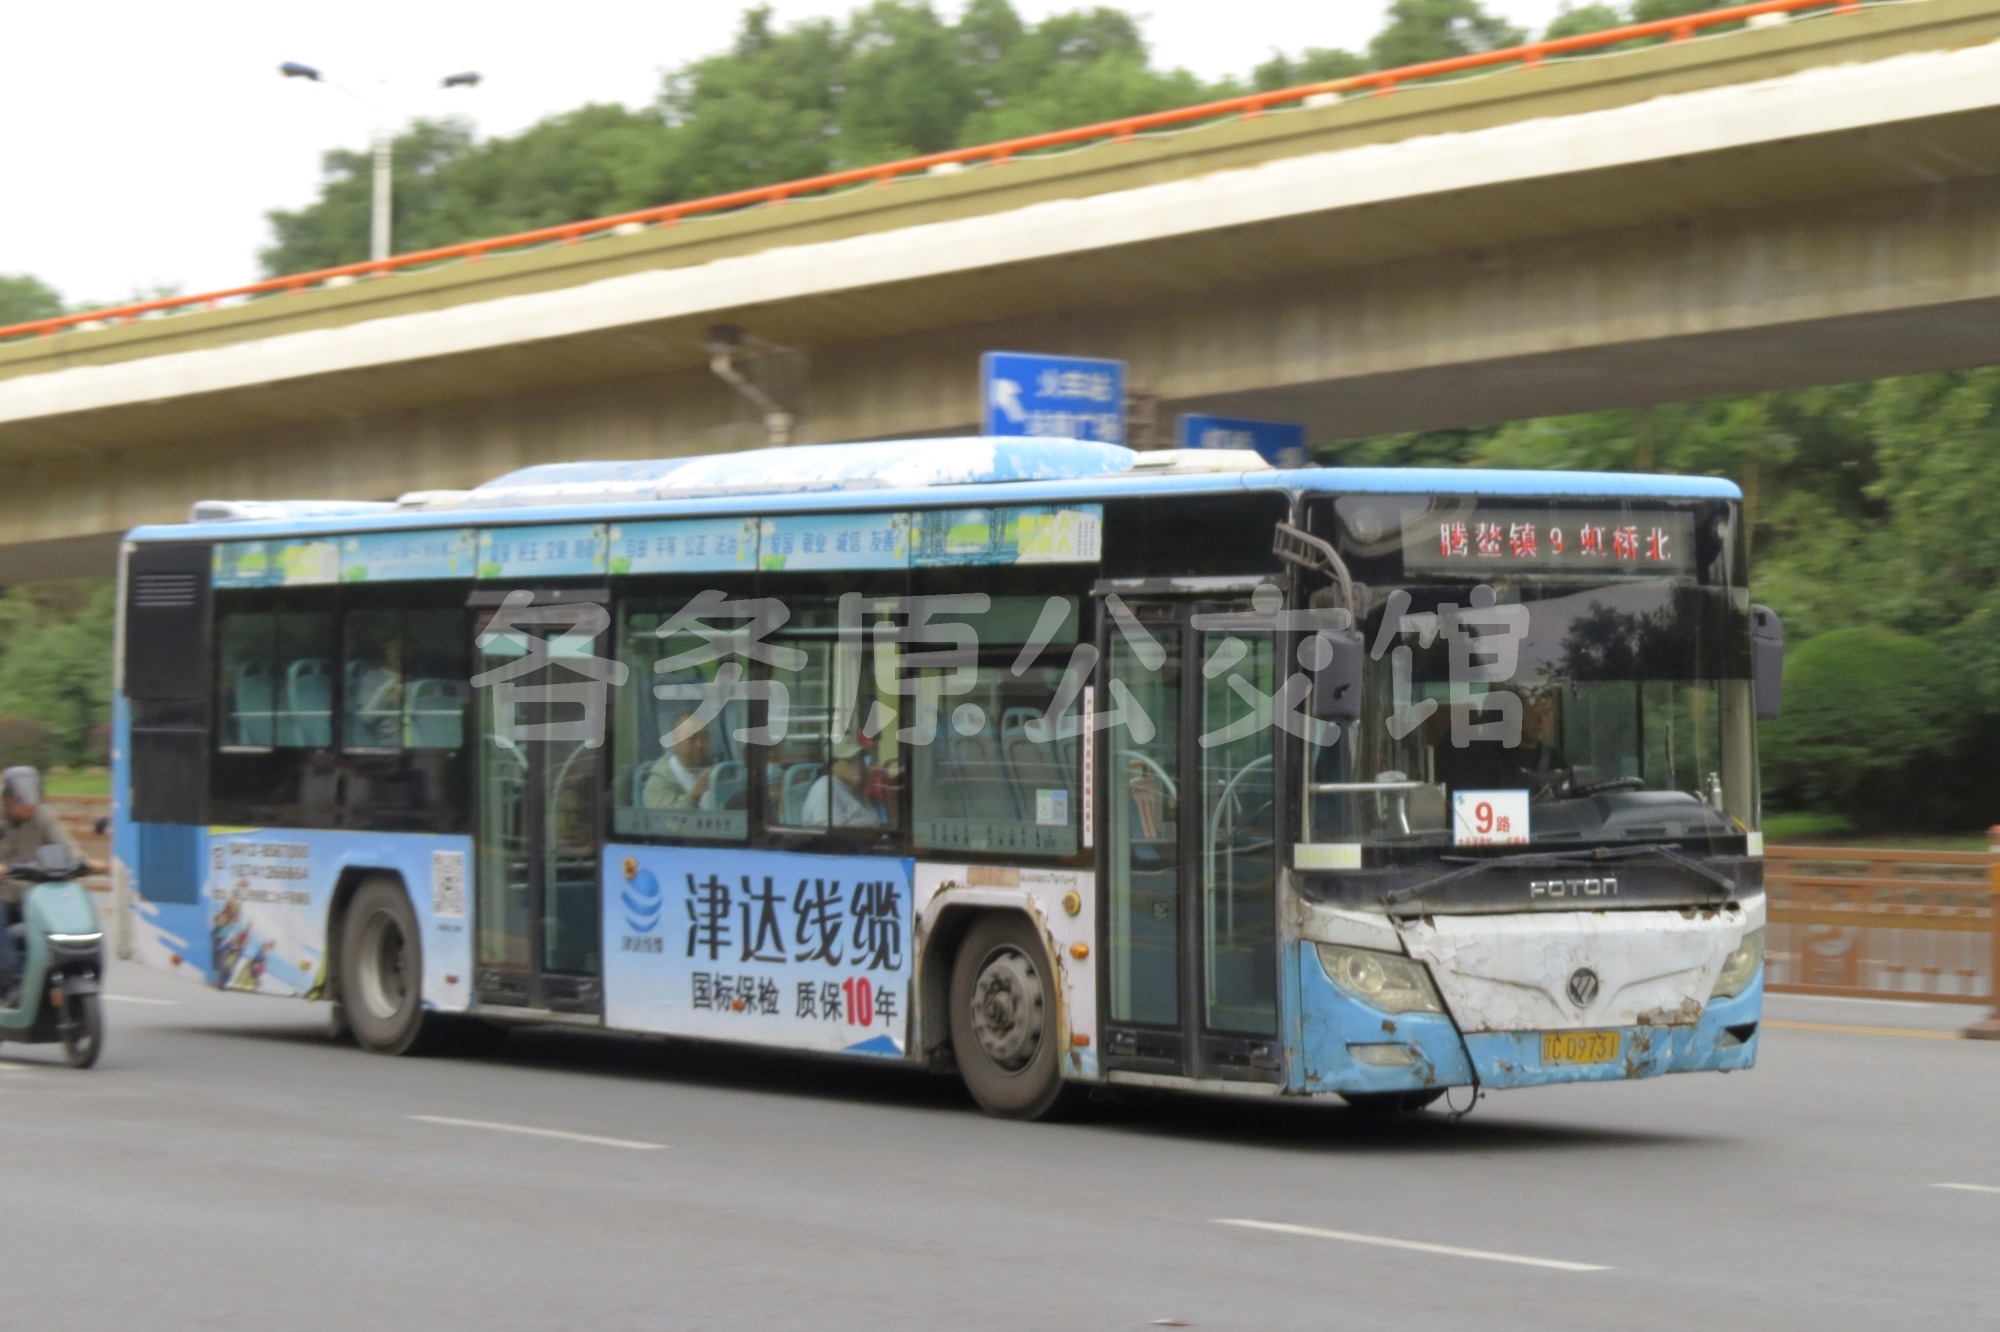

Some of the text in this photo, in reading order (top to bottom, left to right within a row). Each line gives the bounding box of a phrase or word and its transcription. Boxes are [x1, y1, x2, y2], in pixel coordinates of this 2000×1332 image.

[1440, 522, 1671, 560] 腾鳌镇 9 虹桥北
[1530, 877, 1618, 898] FOTON
[684, 872, 903, 971] 津达线缆
[692, 971, 780, 1016] 国标保检
